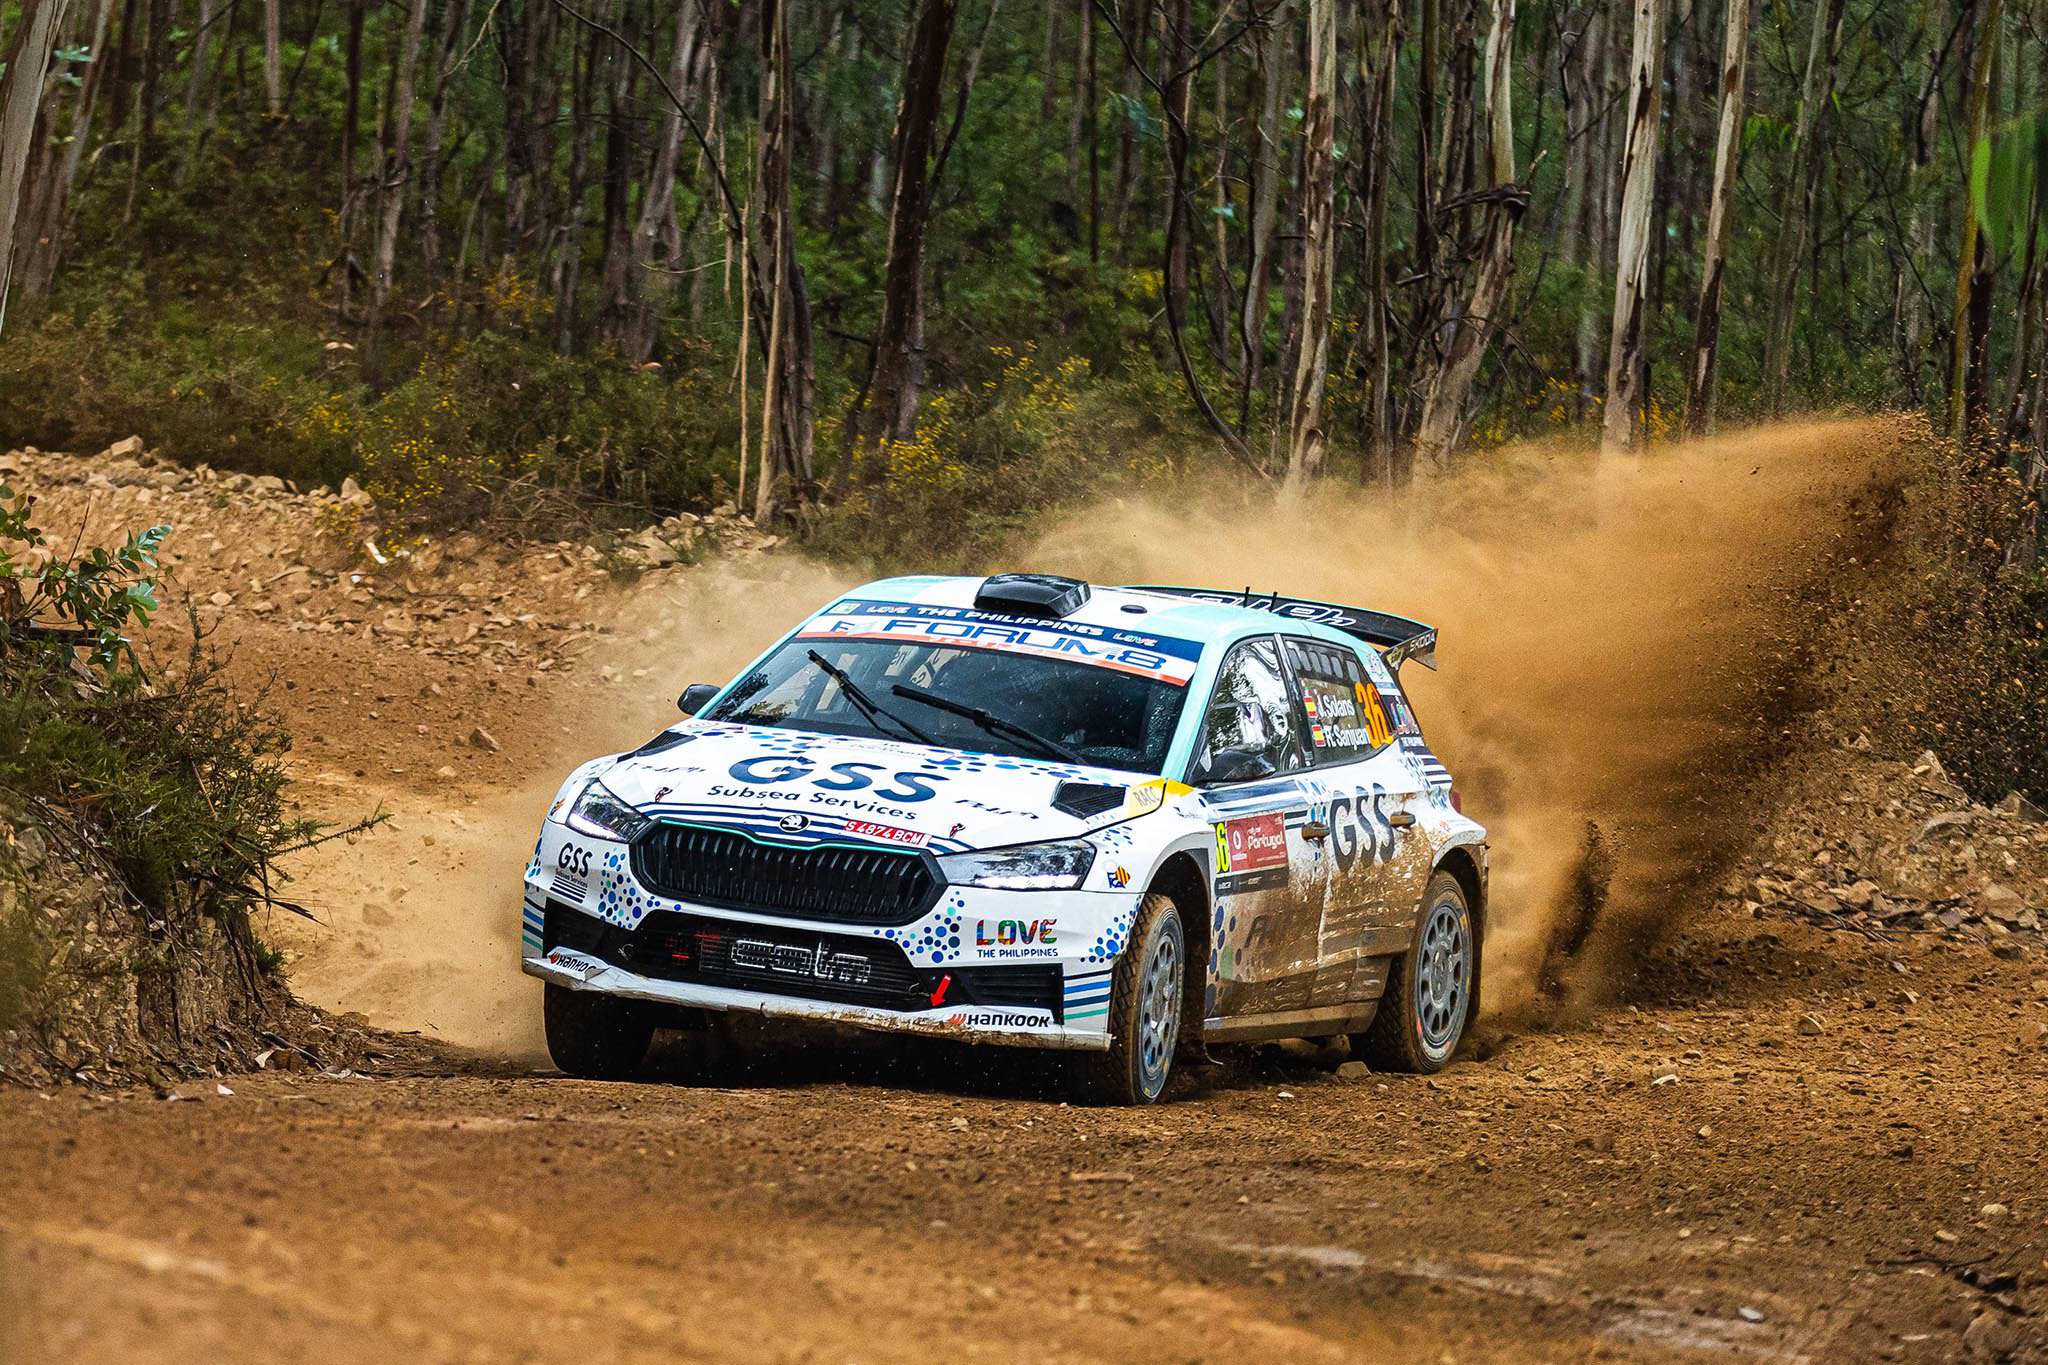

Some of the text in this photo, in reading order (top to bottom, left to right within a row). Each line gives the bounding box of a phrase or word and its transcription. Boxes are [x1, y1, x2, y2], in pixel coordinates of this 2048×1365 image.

[867, 605, 1159, 647] LOVE THE PHILIPPINES LOVE
[883, 619, 1167, 670] FORUM8
[729, 756, 950, 802] GSS
[707, 785, 918, 820] Subsea Services
[1330, 782, 1394, 872] GSS
[559, 842, 593, 878] GSS
[976, 919, 1057, 945] LOVE
[977, 948, 1059, 958] THE PHILIPPINES
